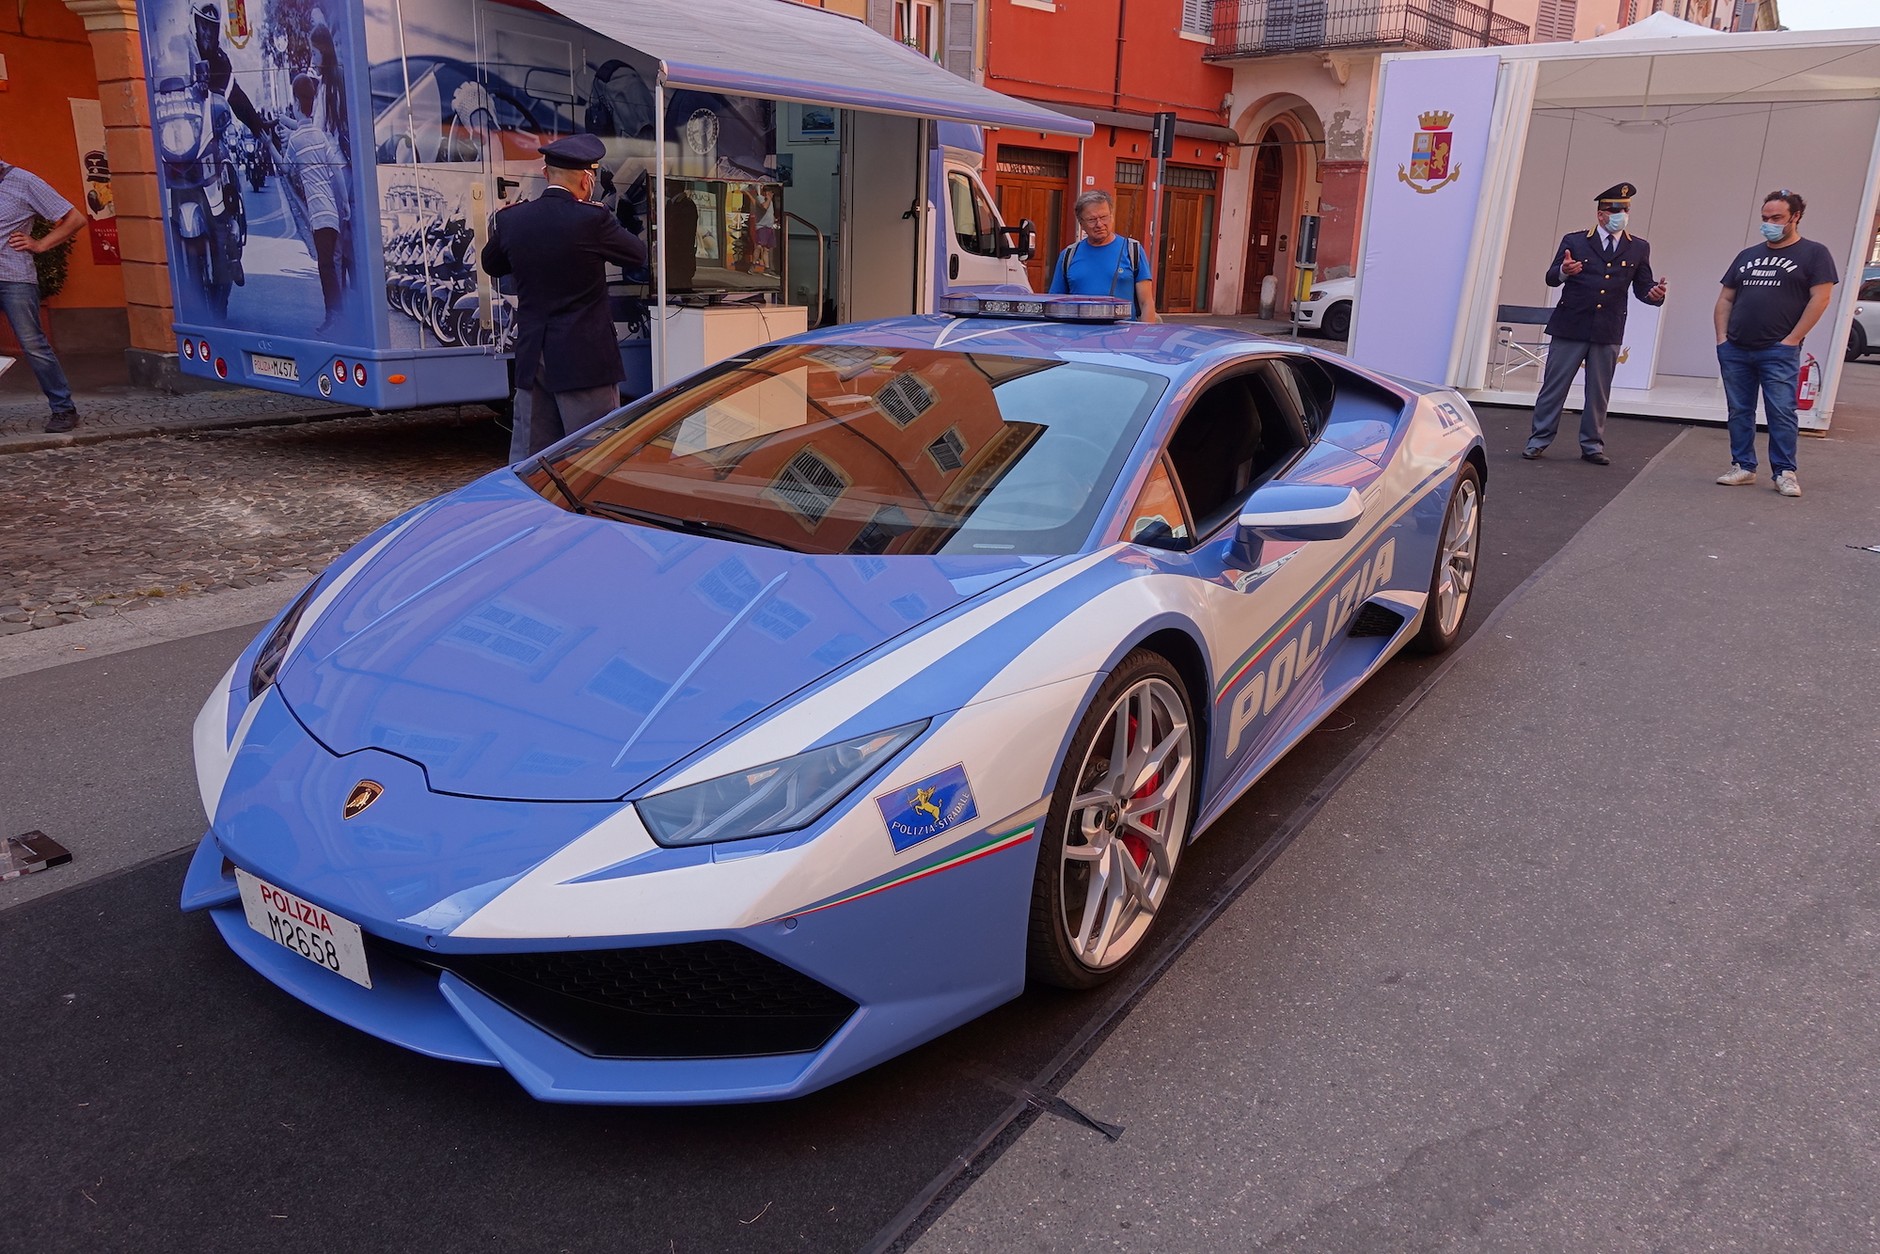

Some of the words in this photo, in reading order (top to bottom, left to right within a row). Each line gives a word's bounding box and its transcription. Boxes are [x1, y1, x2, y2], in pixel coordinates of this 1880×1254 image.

[1739, 256, 1798, 273] PASADENA
[254, 359, 273, 372] POLIZIA
[273, 360, 298, 378] M4574
[1432, 402, 1463, 429] 113
[1225, 536, 1396, 759] POLIZIA
[892, 821, 936, 835] POLIZIA
[938, 792, 970, 829] STRADALE
[260, 884, 335, 936] POLIZIA
[267, 911, 340, 972] M2658
